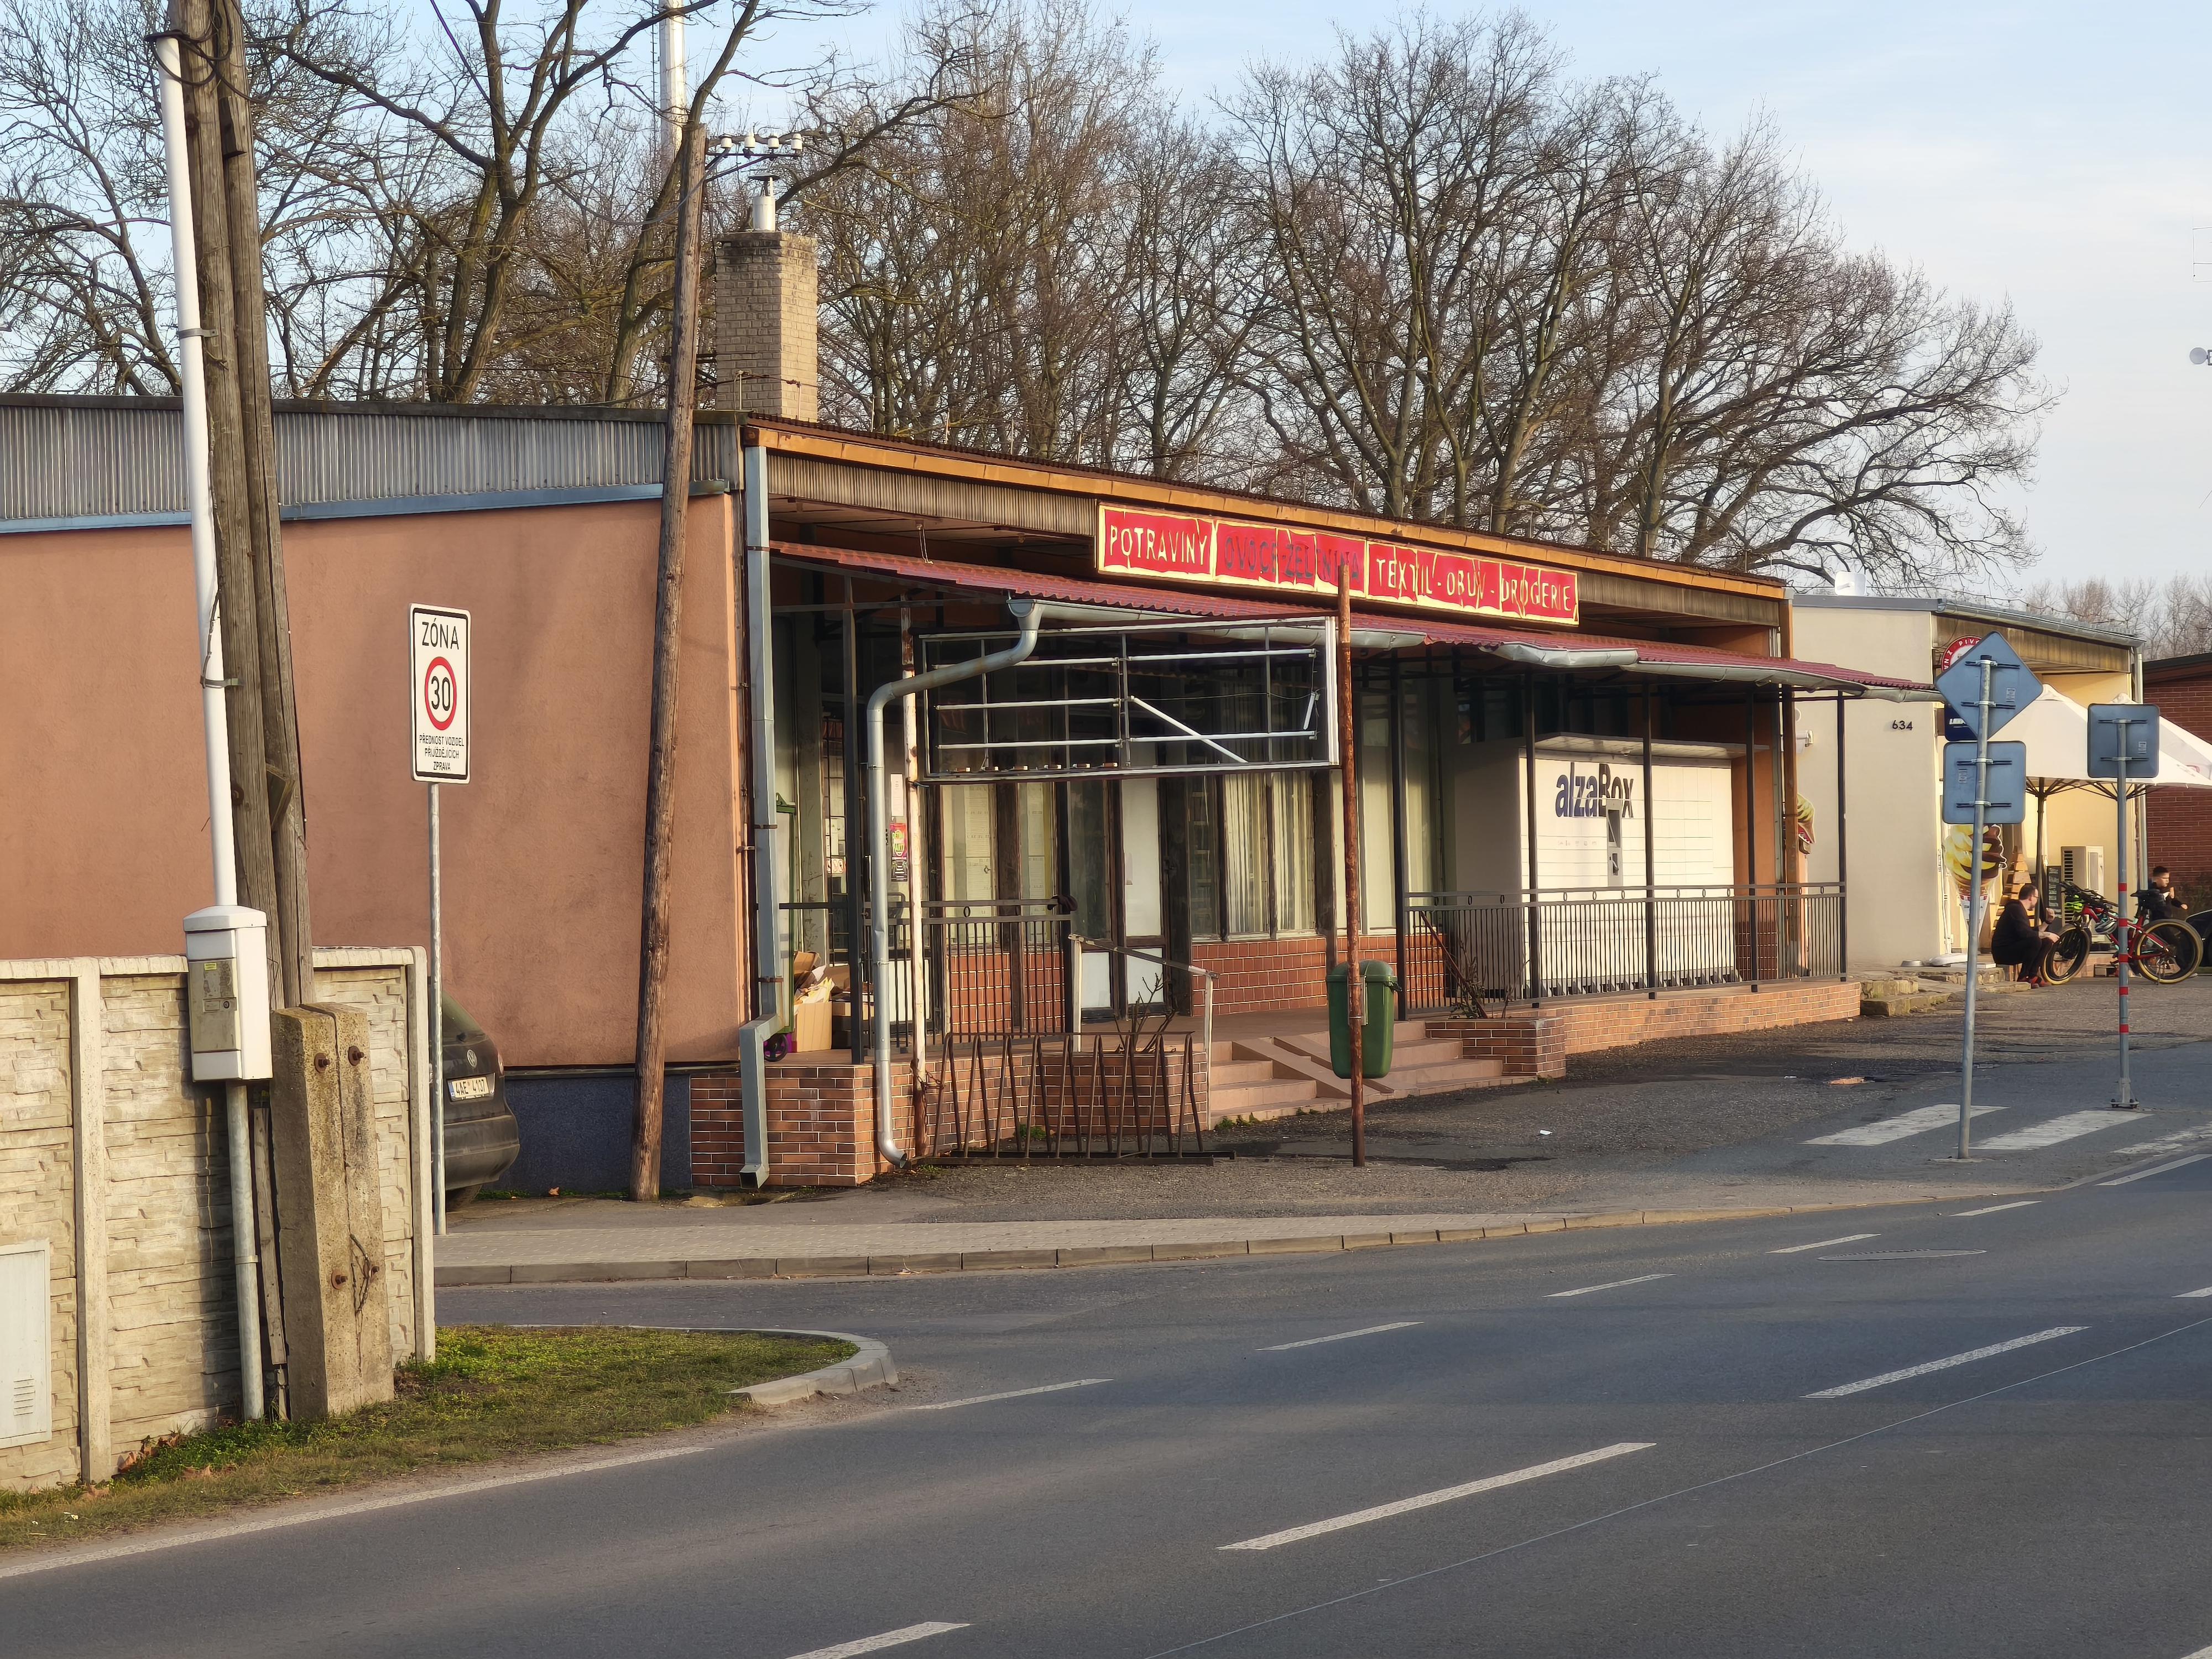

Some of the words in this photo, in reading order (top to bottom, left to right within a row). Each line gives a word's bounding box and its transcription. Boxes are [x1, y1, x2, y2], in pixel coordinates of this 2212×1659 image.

[1110, 524, 1208, 566] POTRAVINY
[1376, 558, 1433, 595] TEXTIL
[1447, 570, 1486, 599] OBUV
[1502, 577, 1572, 611] DROGERIE
[421, 618, 459, 650] ZÓNA
[431, 675, 451, 712] 30
[419, 733, 444, 745] PŘEDNOST
[445, 736, 465, 747] VOZIDEL
[1892, 719, 1913, 731] 634
[433, 761, 451, 771] ZPRAVA
[1555, 761, 1634, 818] alzaBox
